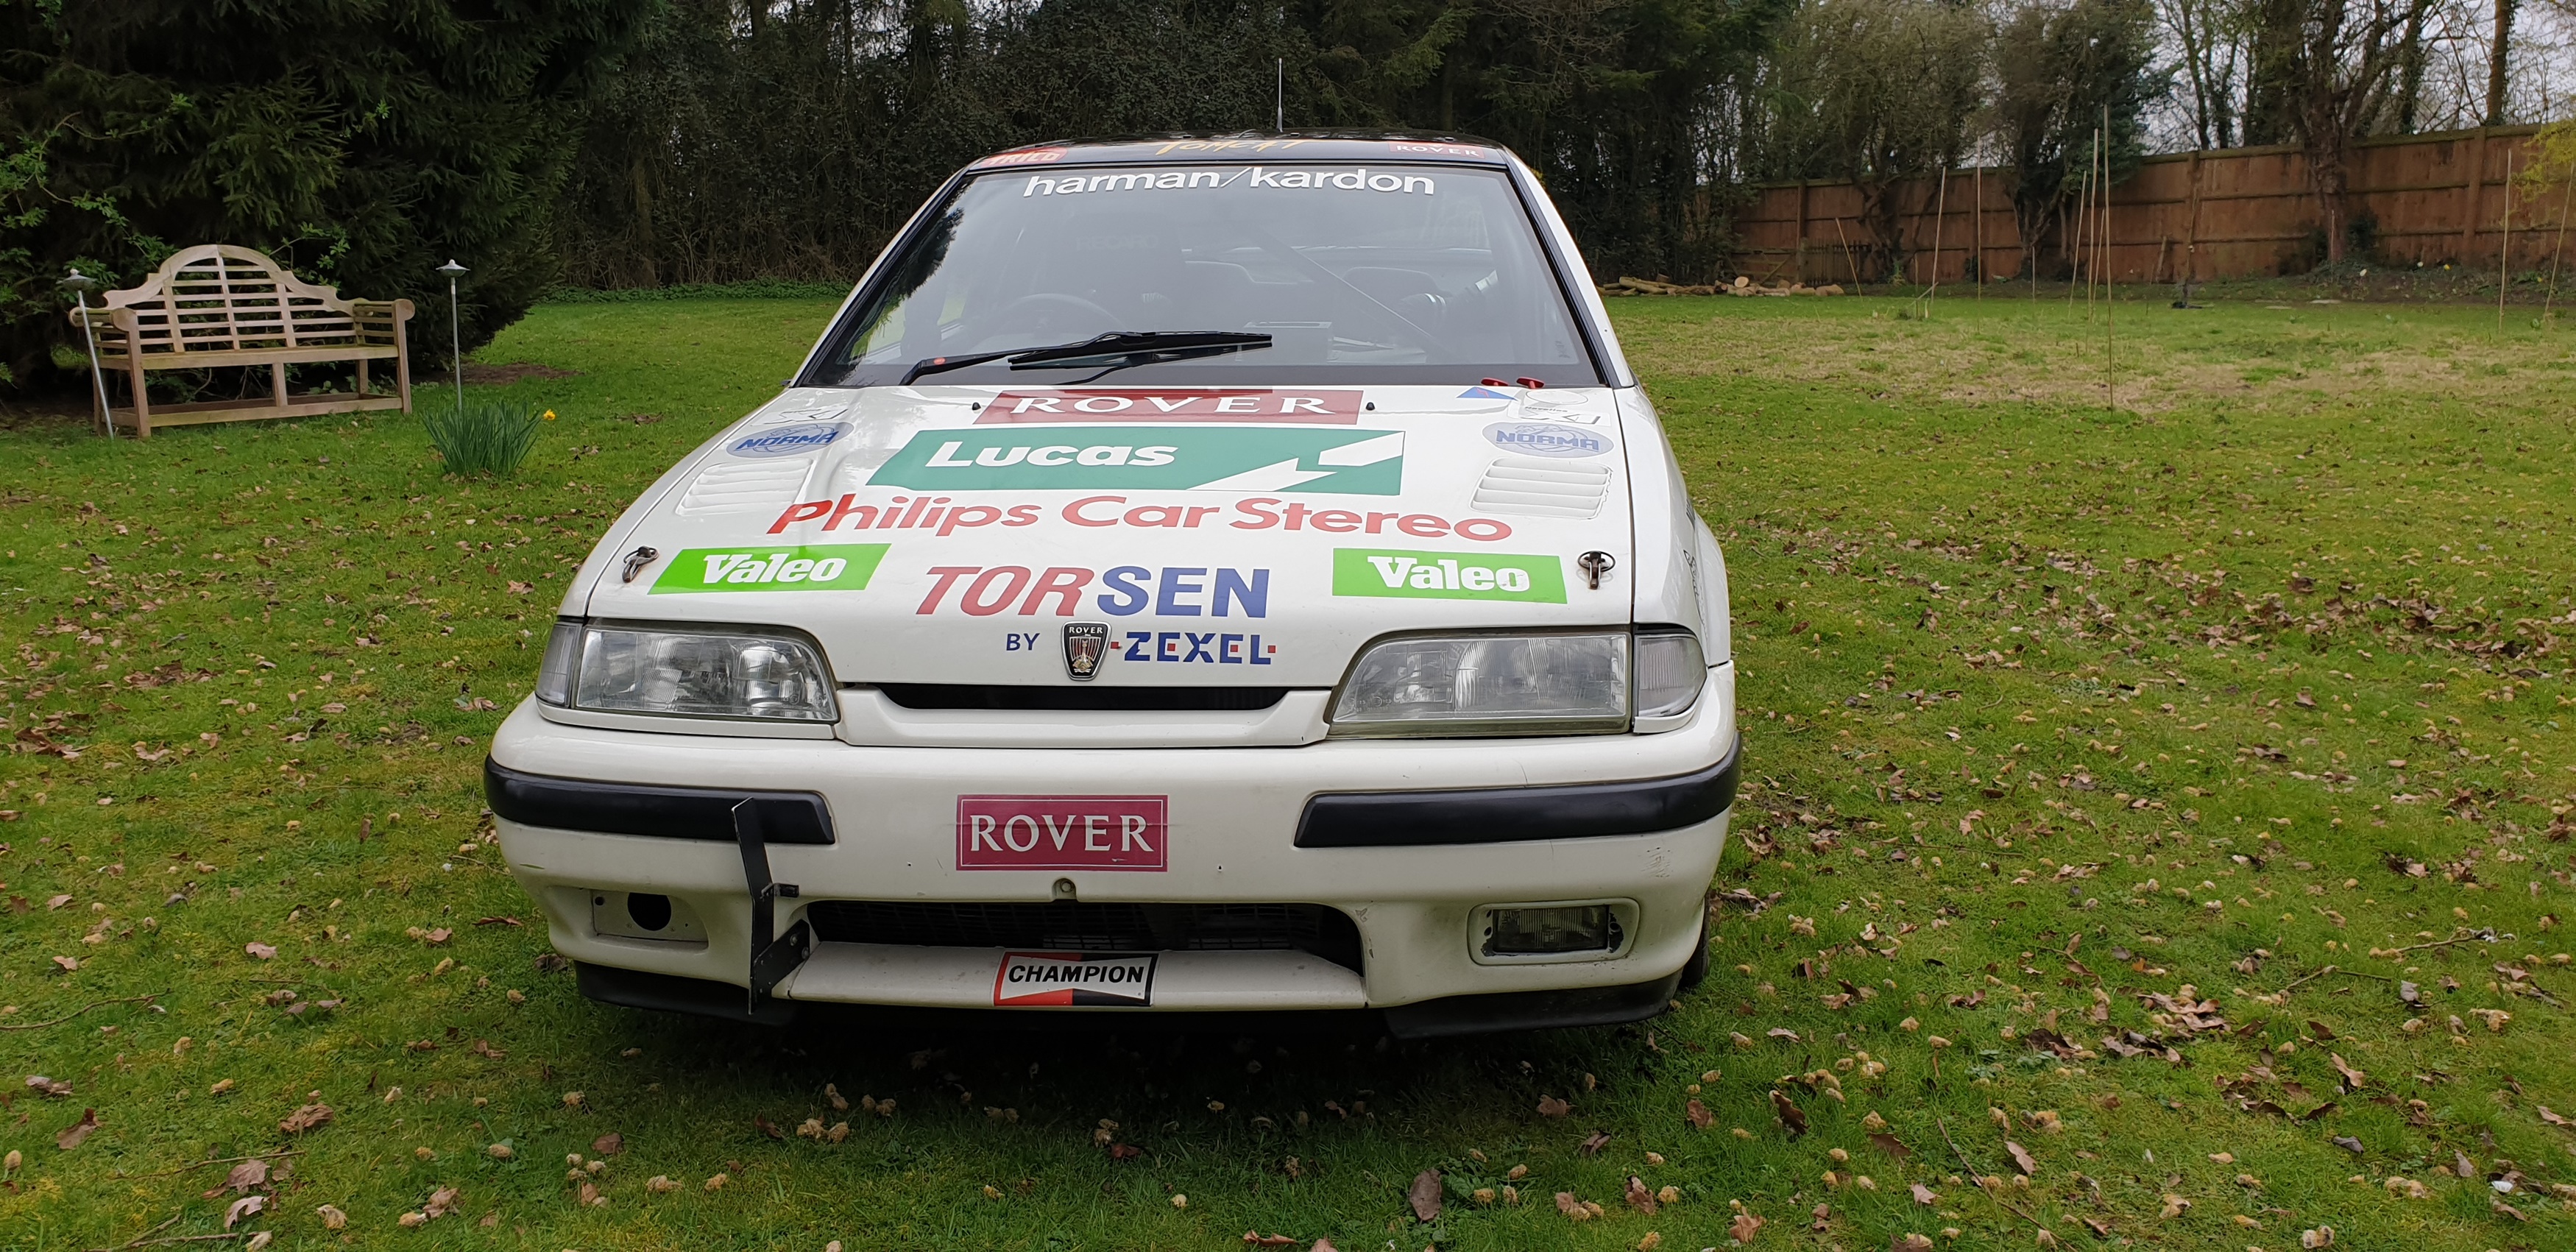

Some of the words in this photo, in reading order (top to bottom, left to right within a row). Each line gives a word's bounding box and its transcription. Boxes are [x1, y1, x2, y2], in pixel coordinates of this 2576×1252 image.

[987, 152, 1060, 165] TRICO
[1397, 145, 1479, 157] ROVER
[1024, 166, 1434, 196] harman/kardon
[1009, 396, 1336, 415] ROVER
[734, 431, 839, 451] NORMA
[1496, 430, 1599, 451] NORMA
[925, 441, 1179, 467] Lucas
[766, 493, 1042, 537] Philips
[1061, 496, 1220, 528] Car
[1228, 498, 1512, 542] Stereo
[702, 555, 847, 584] Valeo
[1367, 556, 1530, 592] Valeo
[916, 565, 1270, 618] TORSEN
[1005, 633, 1040, 651] BY
[970, 815, 1154, 852] ROVER
[1008, 965, 1144, 983] CHAMPION
